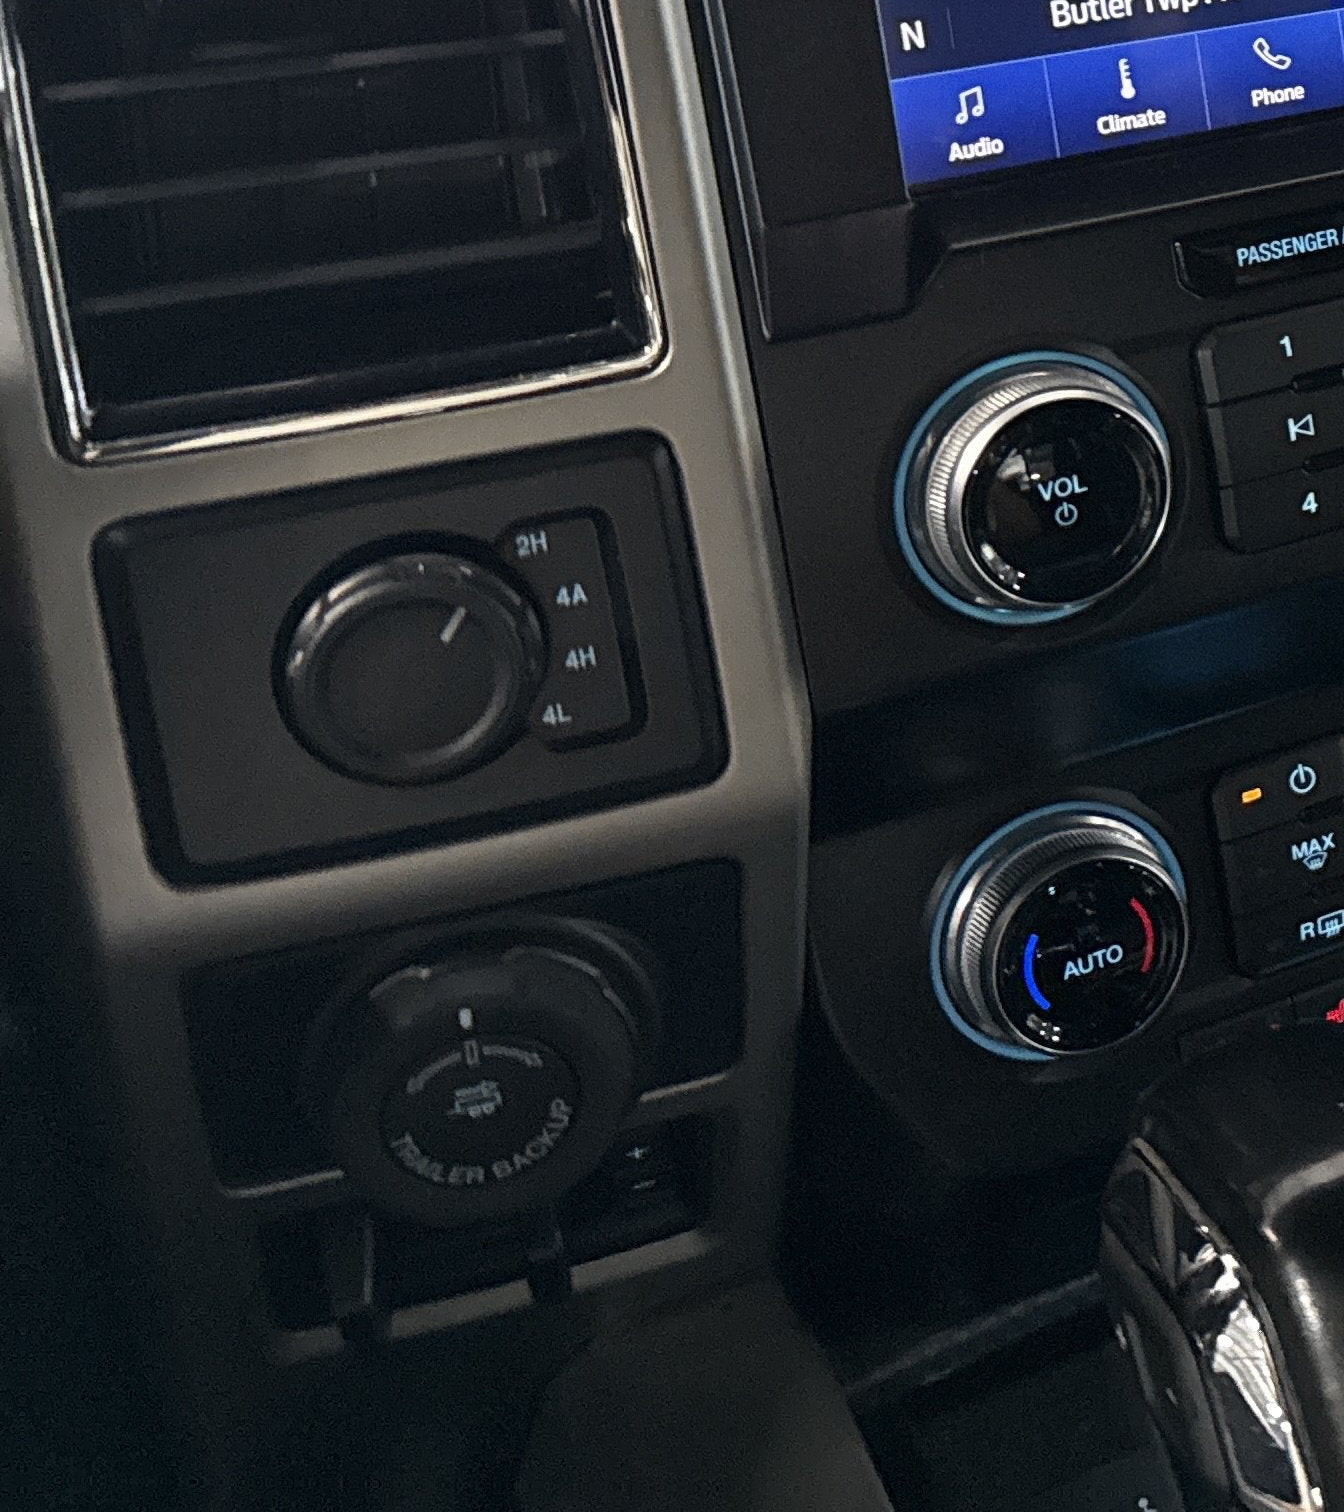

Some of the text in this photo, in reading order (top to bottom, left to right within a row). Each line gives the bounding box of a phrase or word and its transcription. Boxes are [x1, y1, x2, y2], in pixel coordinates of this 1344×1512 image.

[899, 19, 926, 52] N
[1250, 84, 1306, 108] Phone
[1096, 108, 1167, 136] Climate
[948, 136, 1005, 163] Audio
[1236, 228, 1339, 268] PASSENGER
[1279, 335, 1294, 357] 1
[1037, 474, 1089, 502] VOL
[1301, 491, 1319, 514] 4
[514, 529, 549, 558] 2H
[554, 583, 589, 608] 4A
[563, 644, 598, 670] 4H
[540, 703, 573, 727] 4L
[1290, 832, 1336, 861] MAX
[1299, 922, 1316, 942] R
[1062, 943, 1123, 981] AUTO
[491, 1097, 574, 1180] BACKUP
